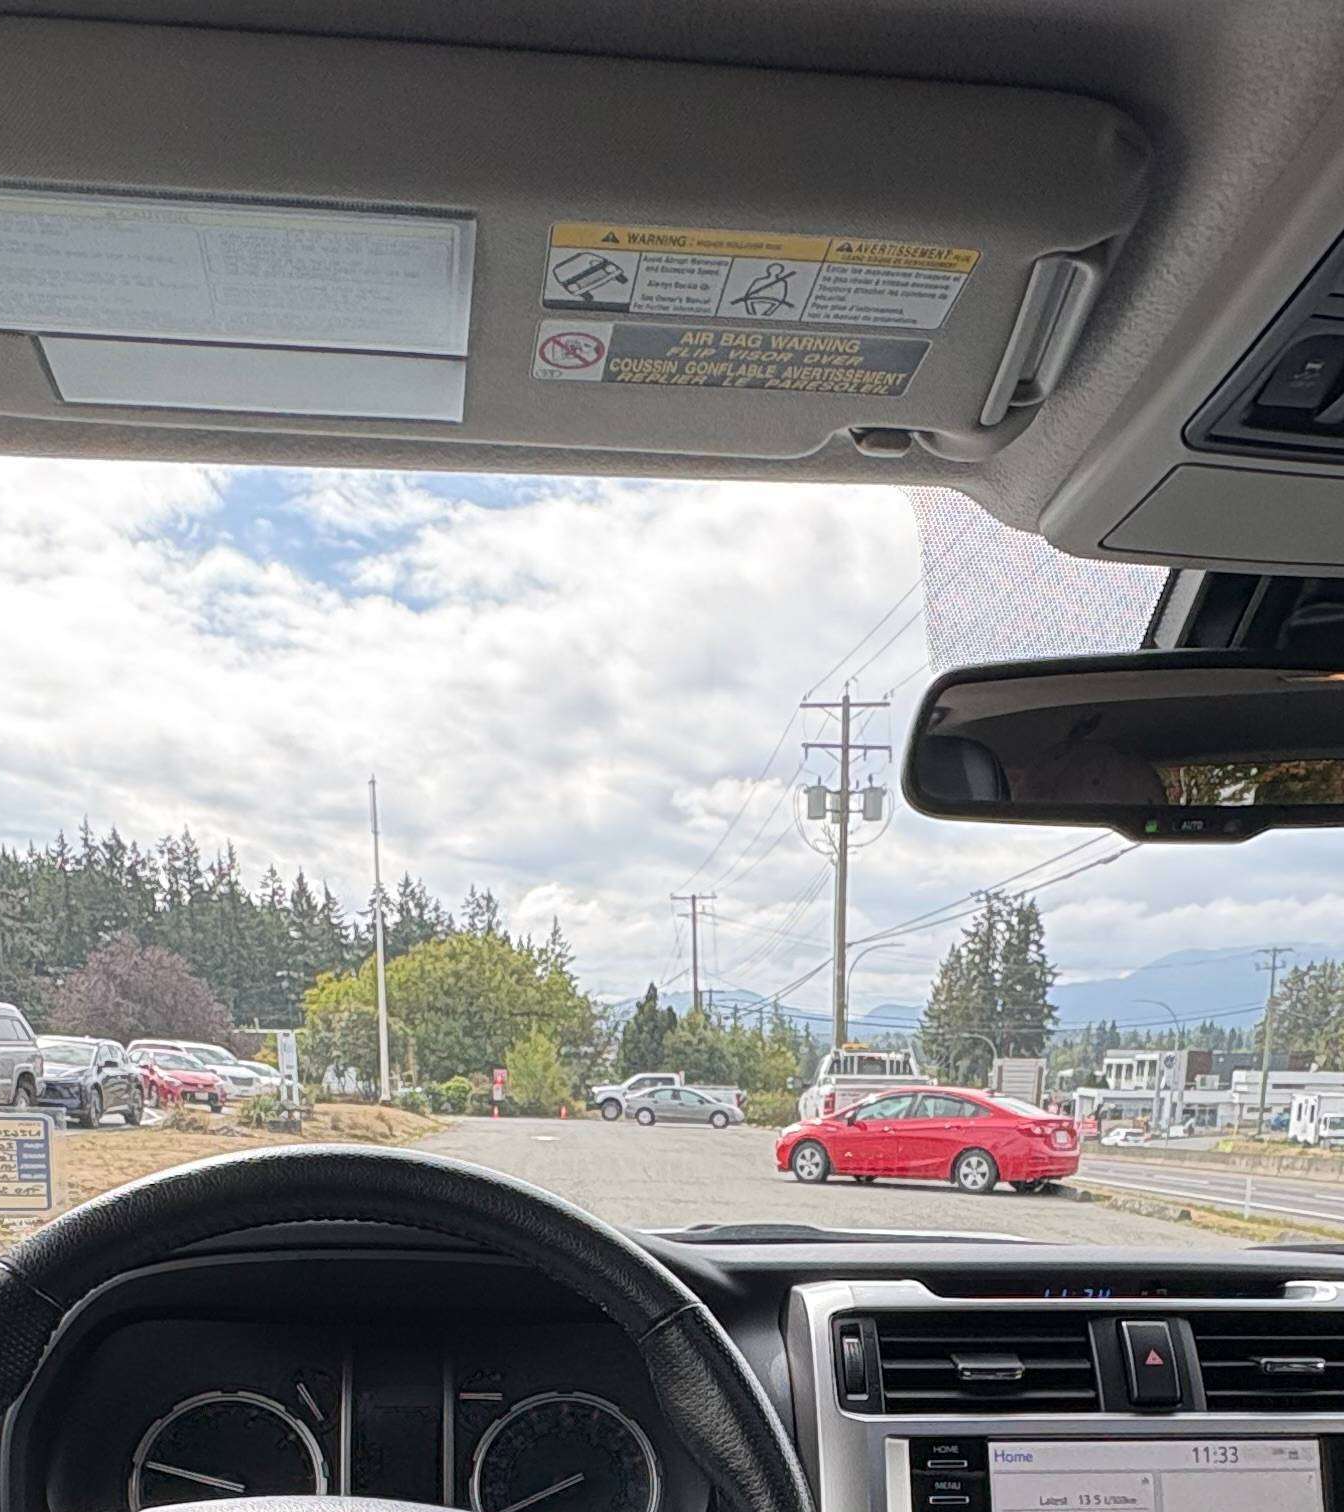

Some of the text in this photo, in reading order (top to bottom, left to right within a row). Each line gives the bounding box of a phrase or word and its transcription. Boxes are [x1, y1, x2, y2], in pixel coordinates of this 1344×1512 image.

[627, 232, 688, 247] WARNING
[855, 243, 952, 261] AVERTISSEMENT
[680, 331, 861, 353] AIR BAG WARNING
[666, 347, 864, 366] FLIP VISOR OVER
[609, 357, 908, 386] COUSSIN GONFLABLE AVERTISSEMENT
[616, 371, 889, 395] REPLIER LE PARESOLEIL
[1181, 820, 1205, 831] AUTO
[932, 1445, 960, 1454] HOME
[994, 1449, 1034, 1463] Home
[1192, 1446, 1239, 1464] 11:33
[934, 1482, 961, 1490] MENU
